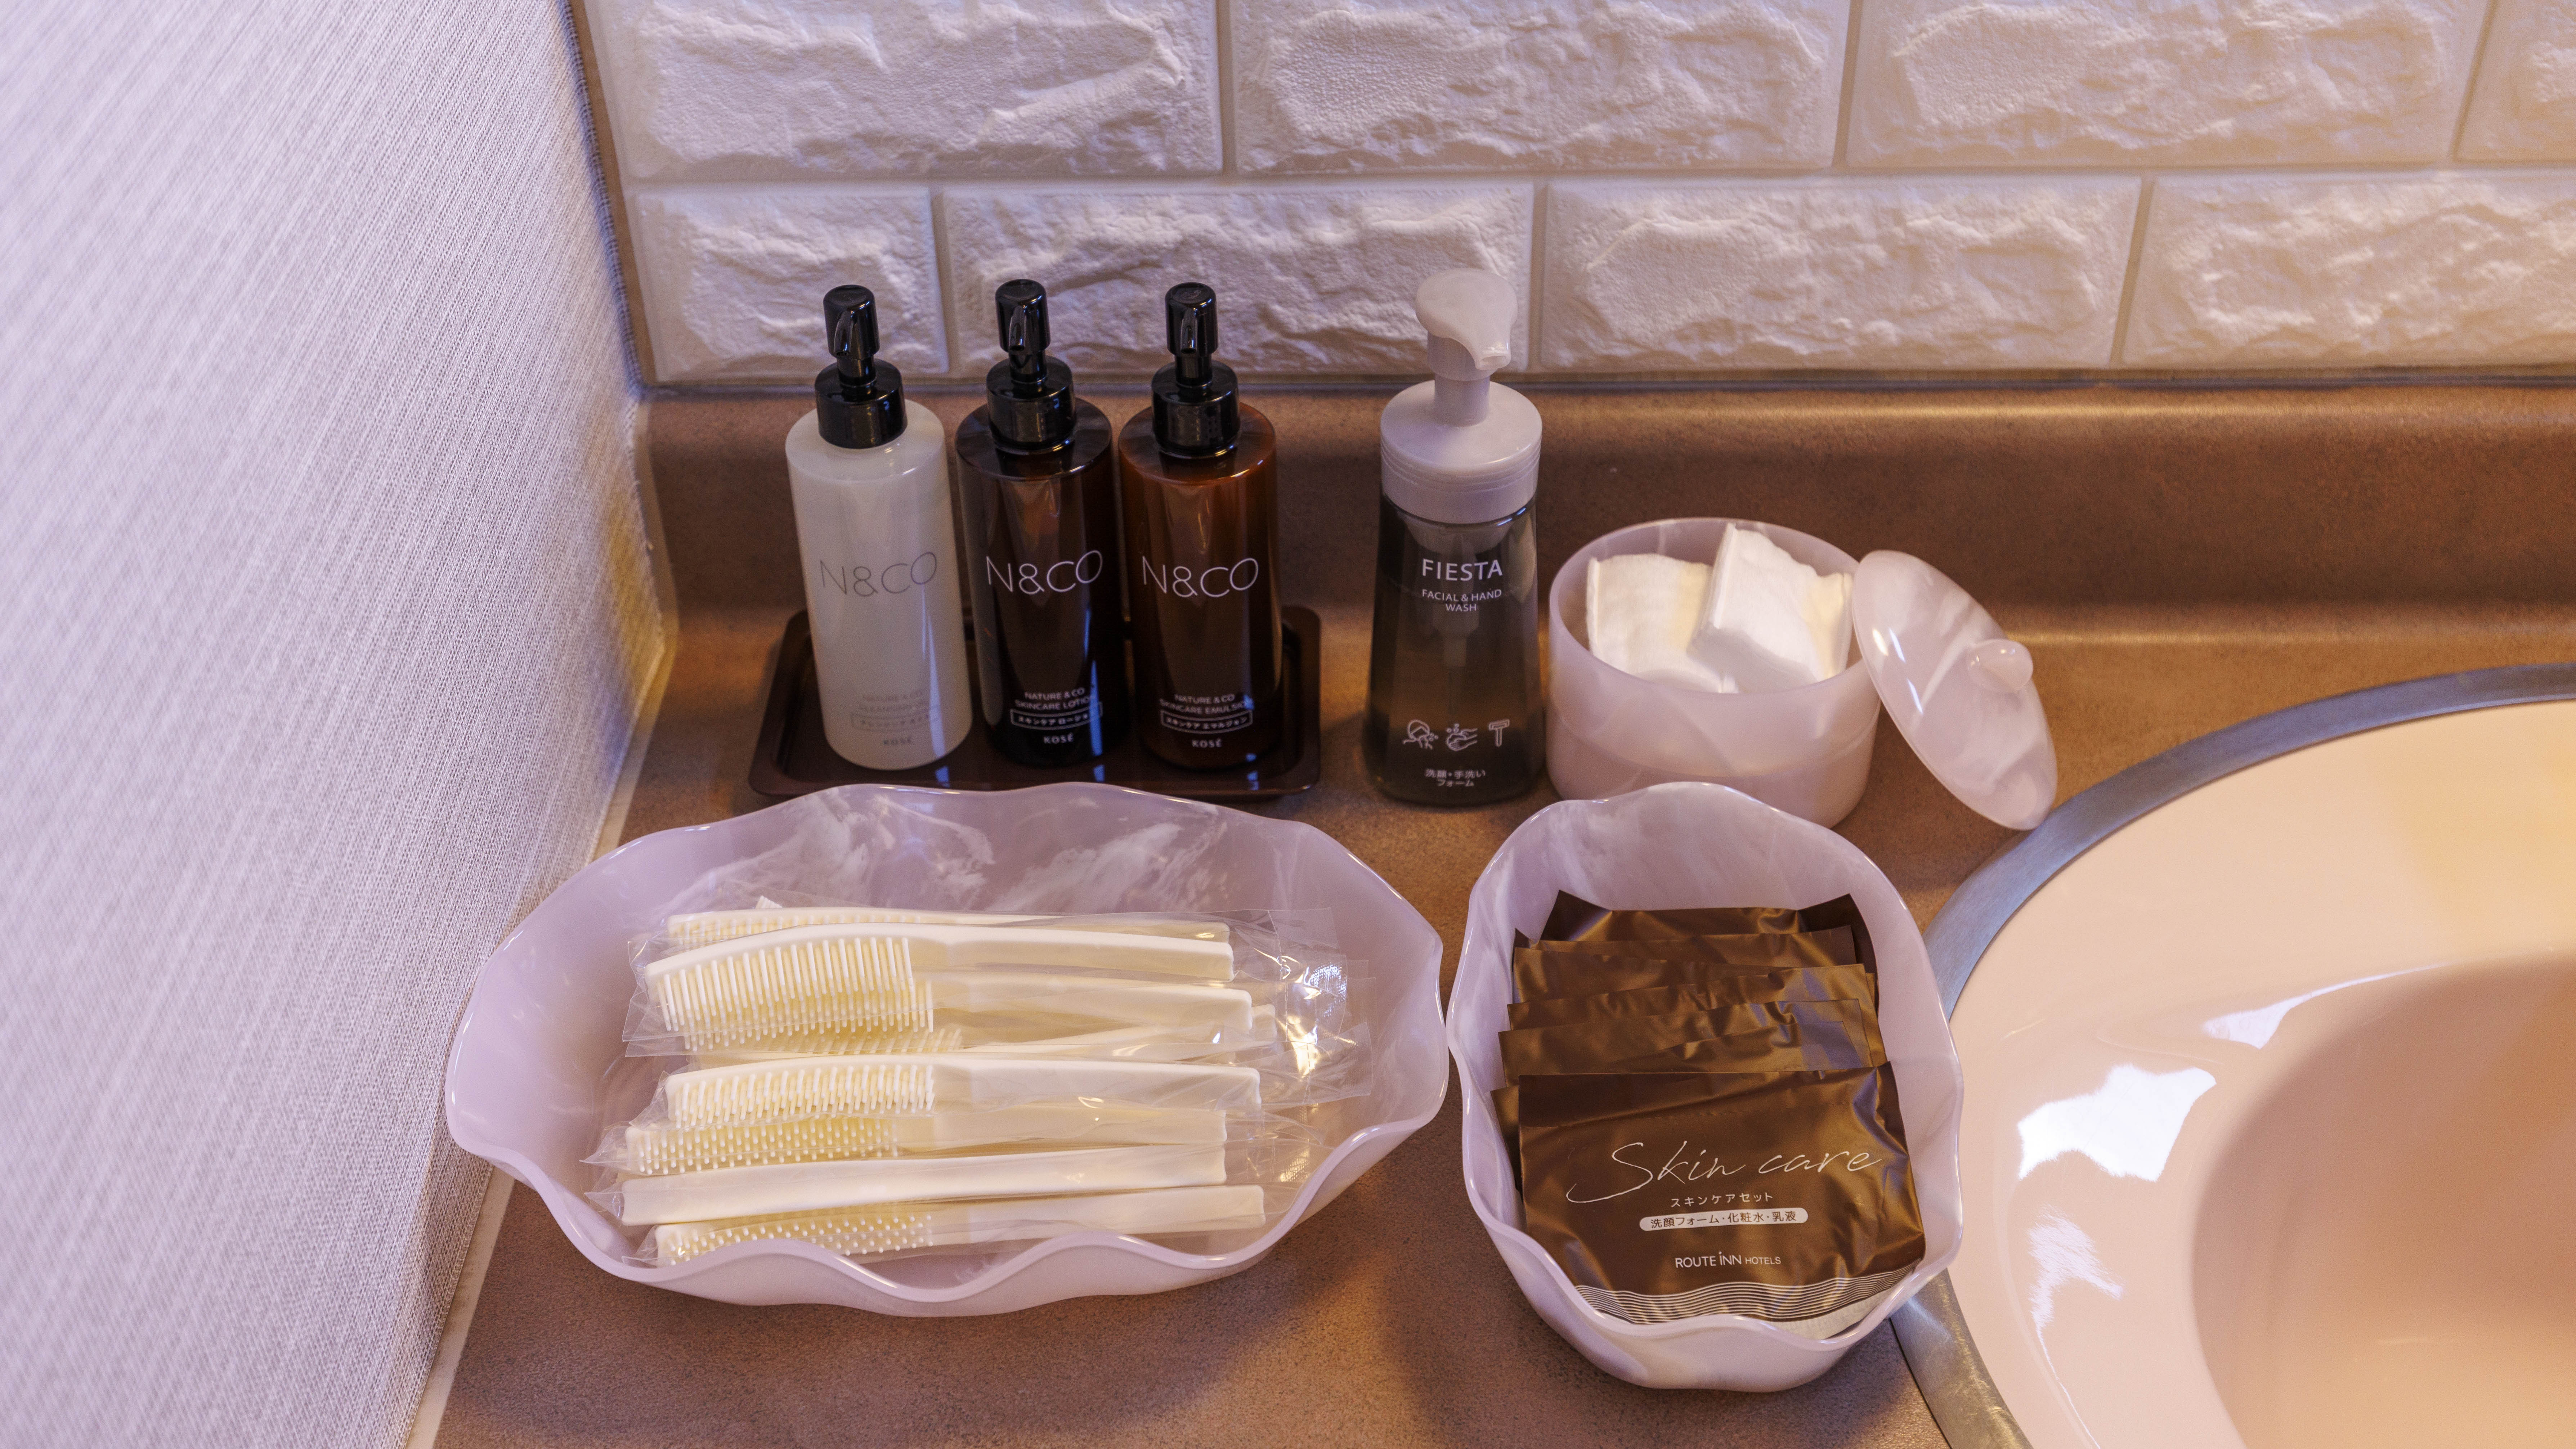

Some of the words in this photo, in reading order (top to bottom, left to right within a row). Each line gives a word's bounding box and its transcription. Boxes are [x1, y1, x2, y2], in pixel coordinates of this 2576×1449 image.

[820, 552, 937, 597] N&CO
[986, 550, 1103, 595] N&CO
[1142, 556, 1259, 598] N&CO
[1423, 558, 1503, 581] FIESTA
[1423, 589, 1459, 602] FACIAL
[1472, 589, 1502, 601] HAND
[1446, 603, 1477, 612] WASH
[1024, 691, 1062, 700] NATURE
[1071, 687, 1085, 697] CO
[1175, 694, 1211, 704] NATURE
[1221, 693, 1235, 702] CO
[1014, 699, 1061, 710] SKINCARE
[1063, 695, 1093, 709] LOTIO
[1437, 779, 1474, 788] フォーム
[1566, 1140, 1746, 1203] Skin
[1758, 1150, 1881, 1175] care
[1671, 1192, 1773, 1207] スキンケアセット
[1675, 1256, 1716, 1268] ROUTE
[1745, 1256, 1781, 1265] HOTELS
